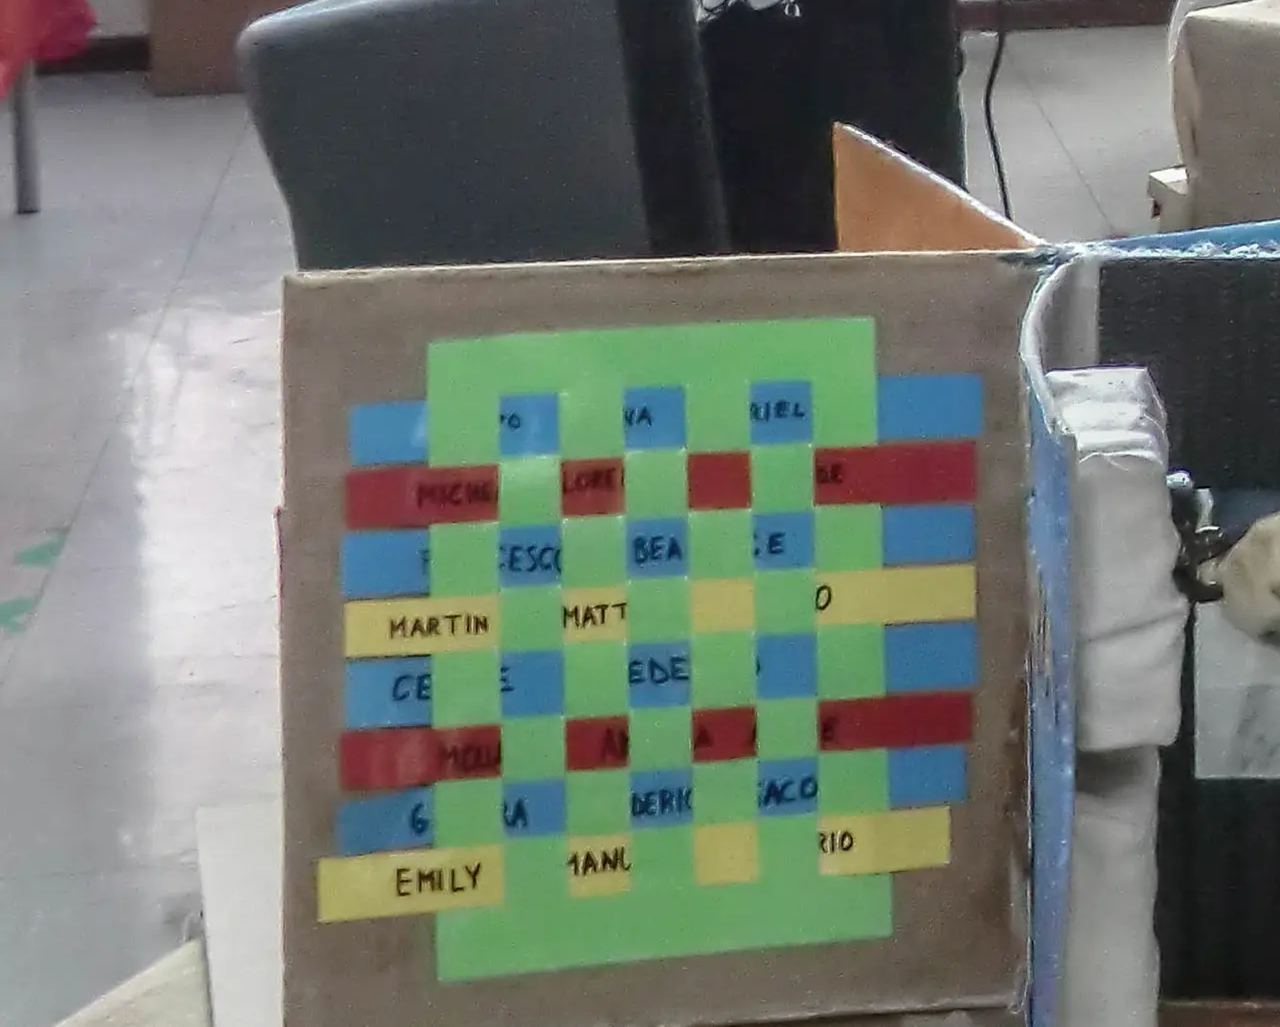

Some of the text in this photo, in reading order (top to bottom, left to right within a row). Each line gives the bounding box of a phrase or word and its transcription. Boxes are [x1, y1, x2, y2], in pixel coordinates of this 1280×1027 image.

[417, 479, 499, 509] MICHE
[633, 534, 682, 564] BEA
[389, 614, 489, 640] MARTIN
[562, 602, 627, 629] MATT
[391, 673, 431, 702] CE
[627, 655, 690, 686] EDE
[758, 774, 819, 807] ACO
[396, 862, 482, 897] EMILY
